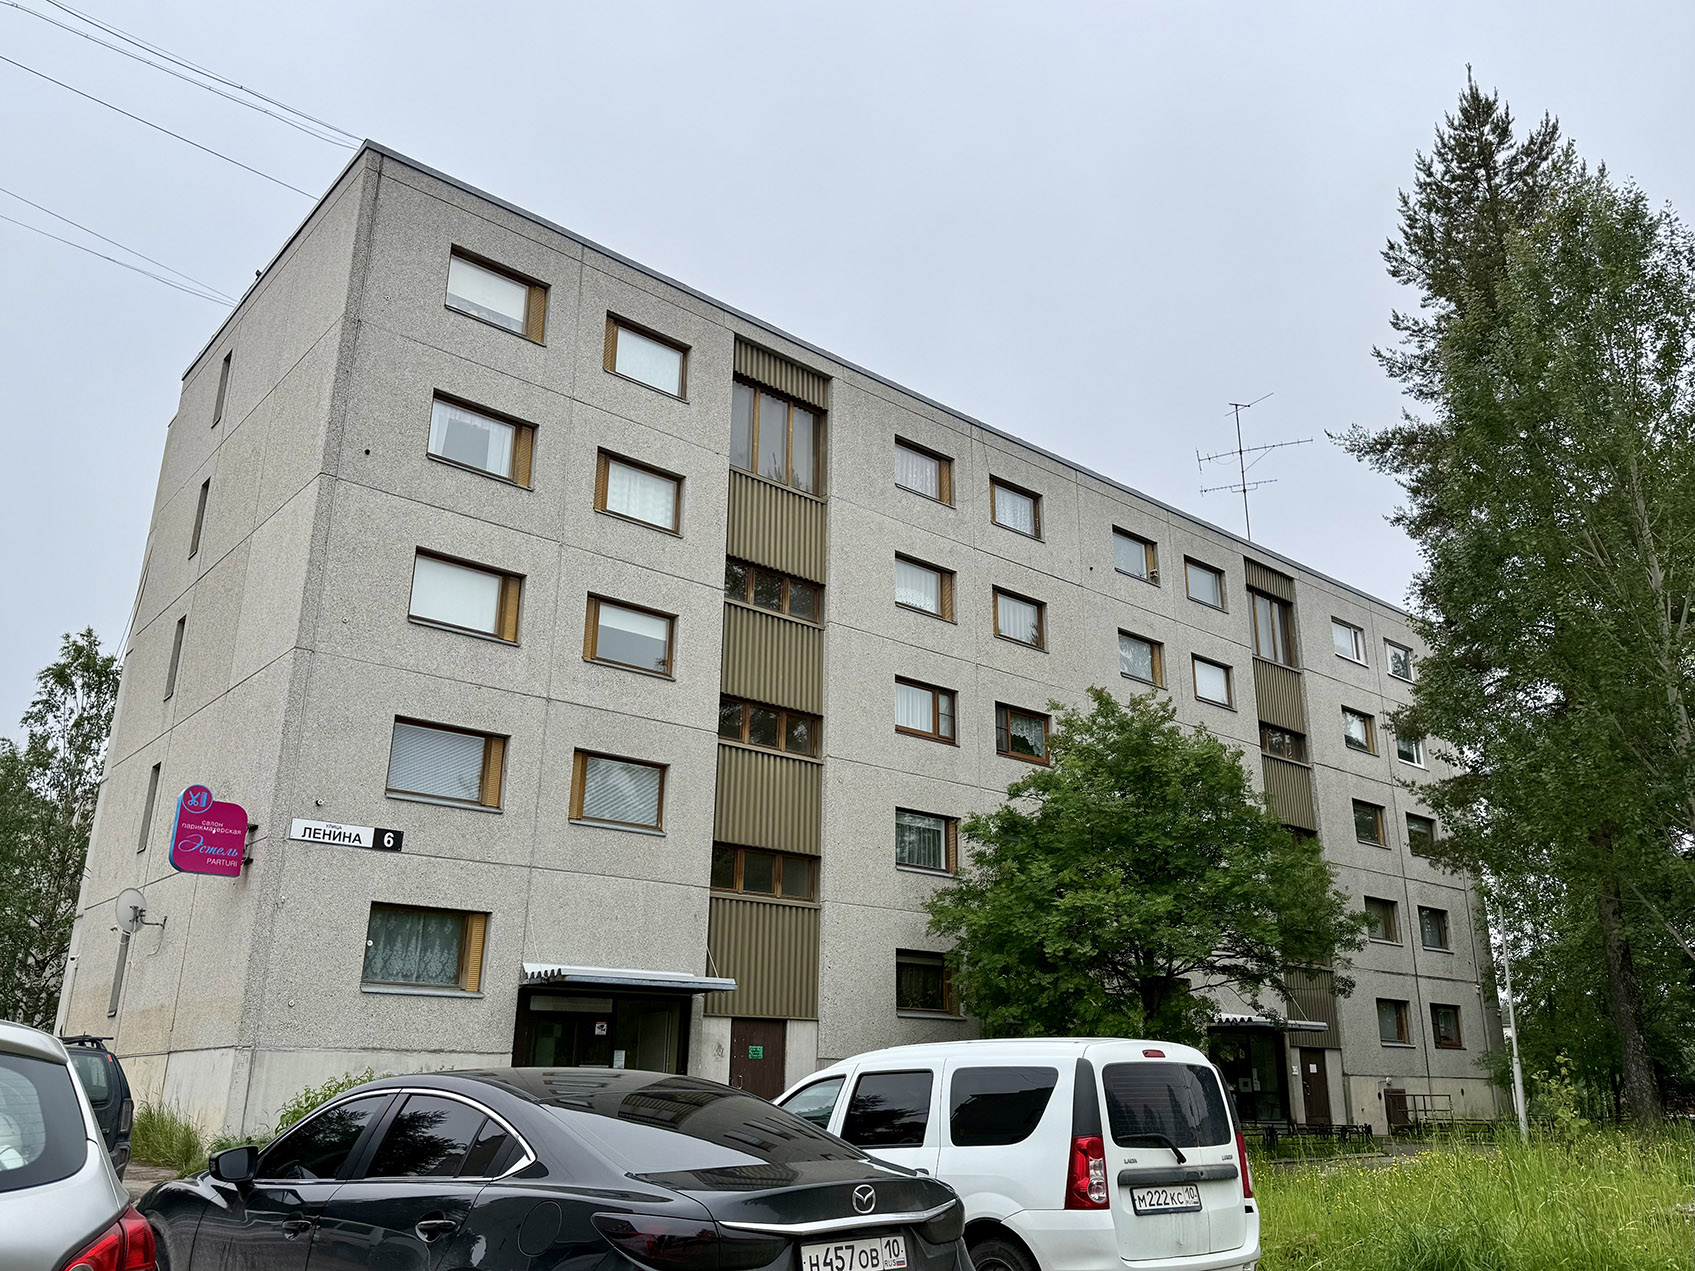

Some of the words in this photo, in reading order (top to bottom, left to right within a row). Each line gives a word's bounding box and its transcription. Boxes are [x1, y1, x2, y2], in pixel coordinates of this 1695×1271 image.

[178, 833, 239, 857] Эстель
[301, 826, 362, 845] ЛЕНИНА
[383, 832, 394, 848] 6
[206, 857, 238, 867] PARTURI
[1185, 1187, 1196, 1200] 10
[884, 1238, 901, 1259] 10
[884, 1259, 897, 1267] RUS
